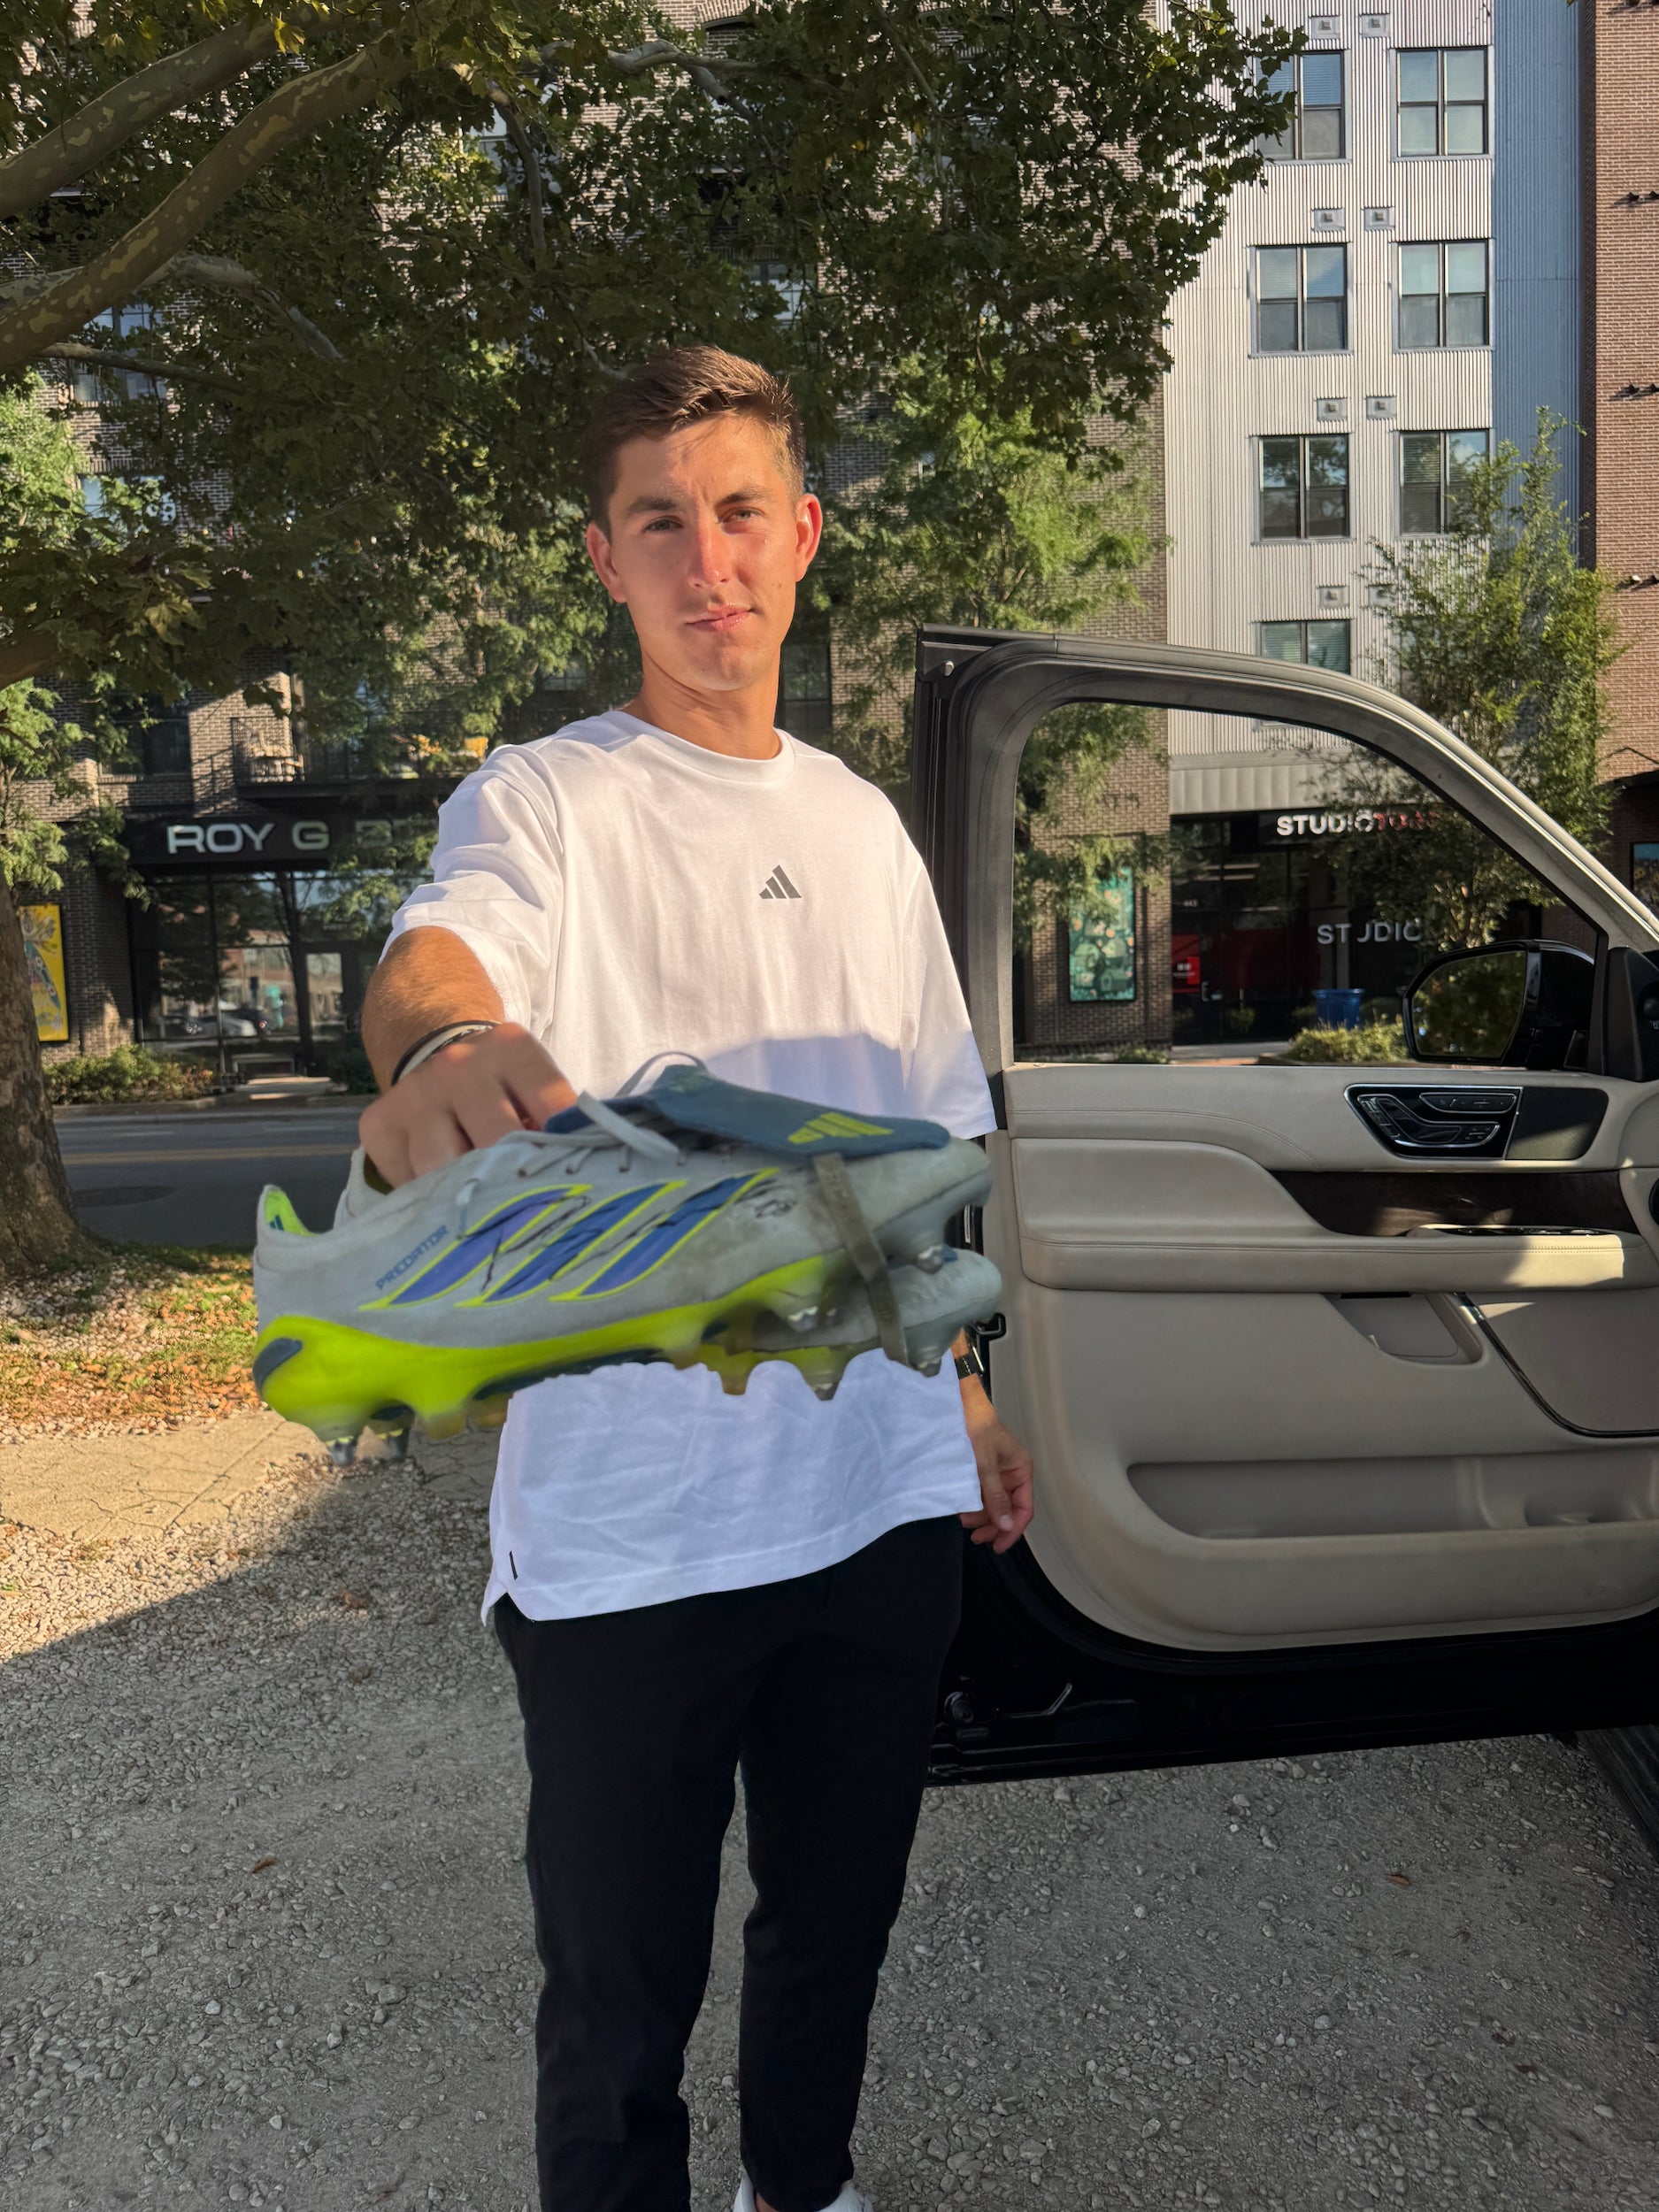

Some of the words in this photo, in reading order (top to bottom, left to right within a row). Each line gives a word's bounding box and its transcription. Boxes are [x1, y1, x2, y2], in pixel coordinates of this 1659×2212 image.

[167, 823, 275, 854] ROY
[292, 820, 329, 851] G
[375, 1225, 449, 1290] PREDATOR
